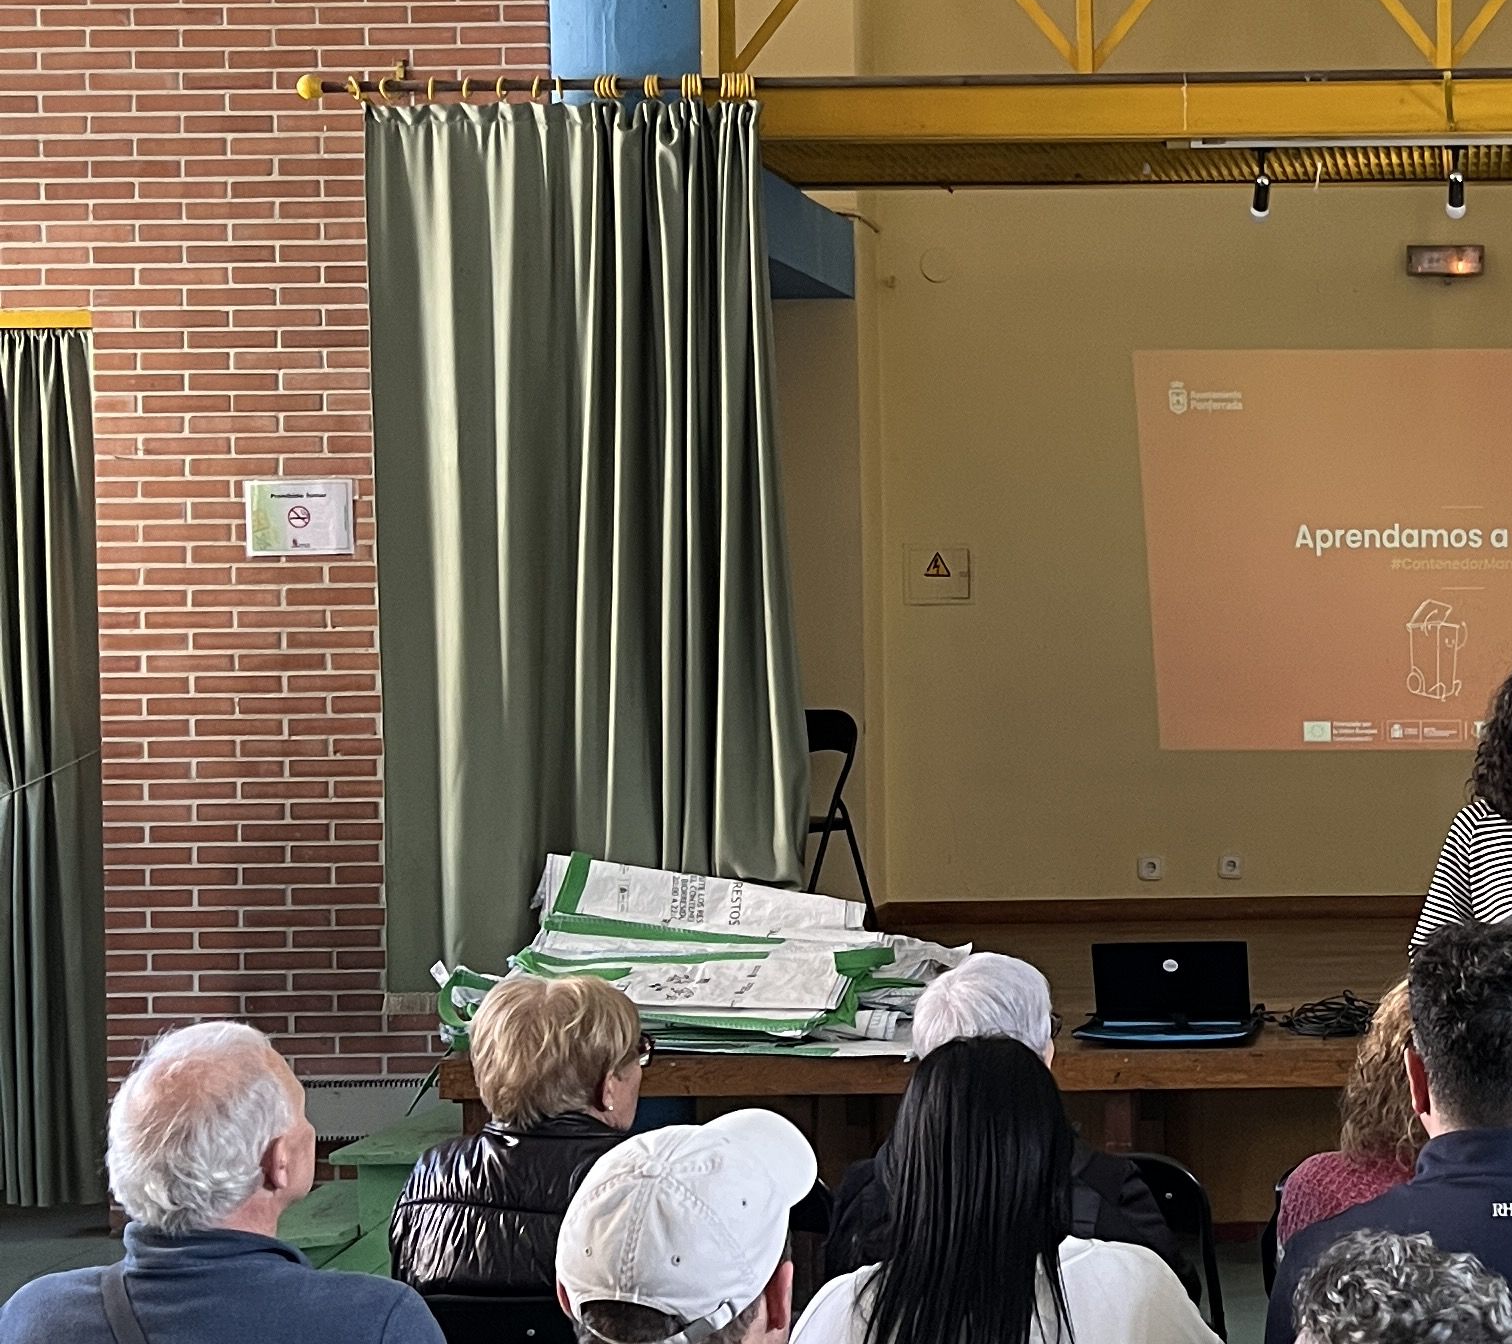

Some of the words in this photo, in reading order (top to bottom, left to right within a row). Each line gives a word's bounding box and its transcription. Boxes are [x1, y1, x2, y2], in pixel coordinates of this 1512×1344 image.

[1295, 523, 1483, 557] Aprendamos
[1490, 529, 1509, 549] a
[729, 881, 743, 926] RESTOS
